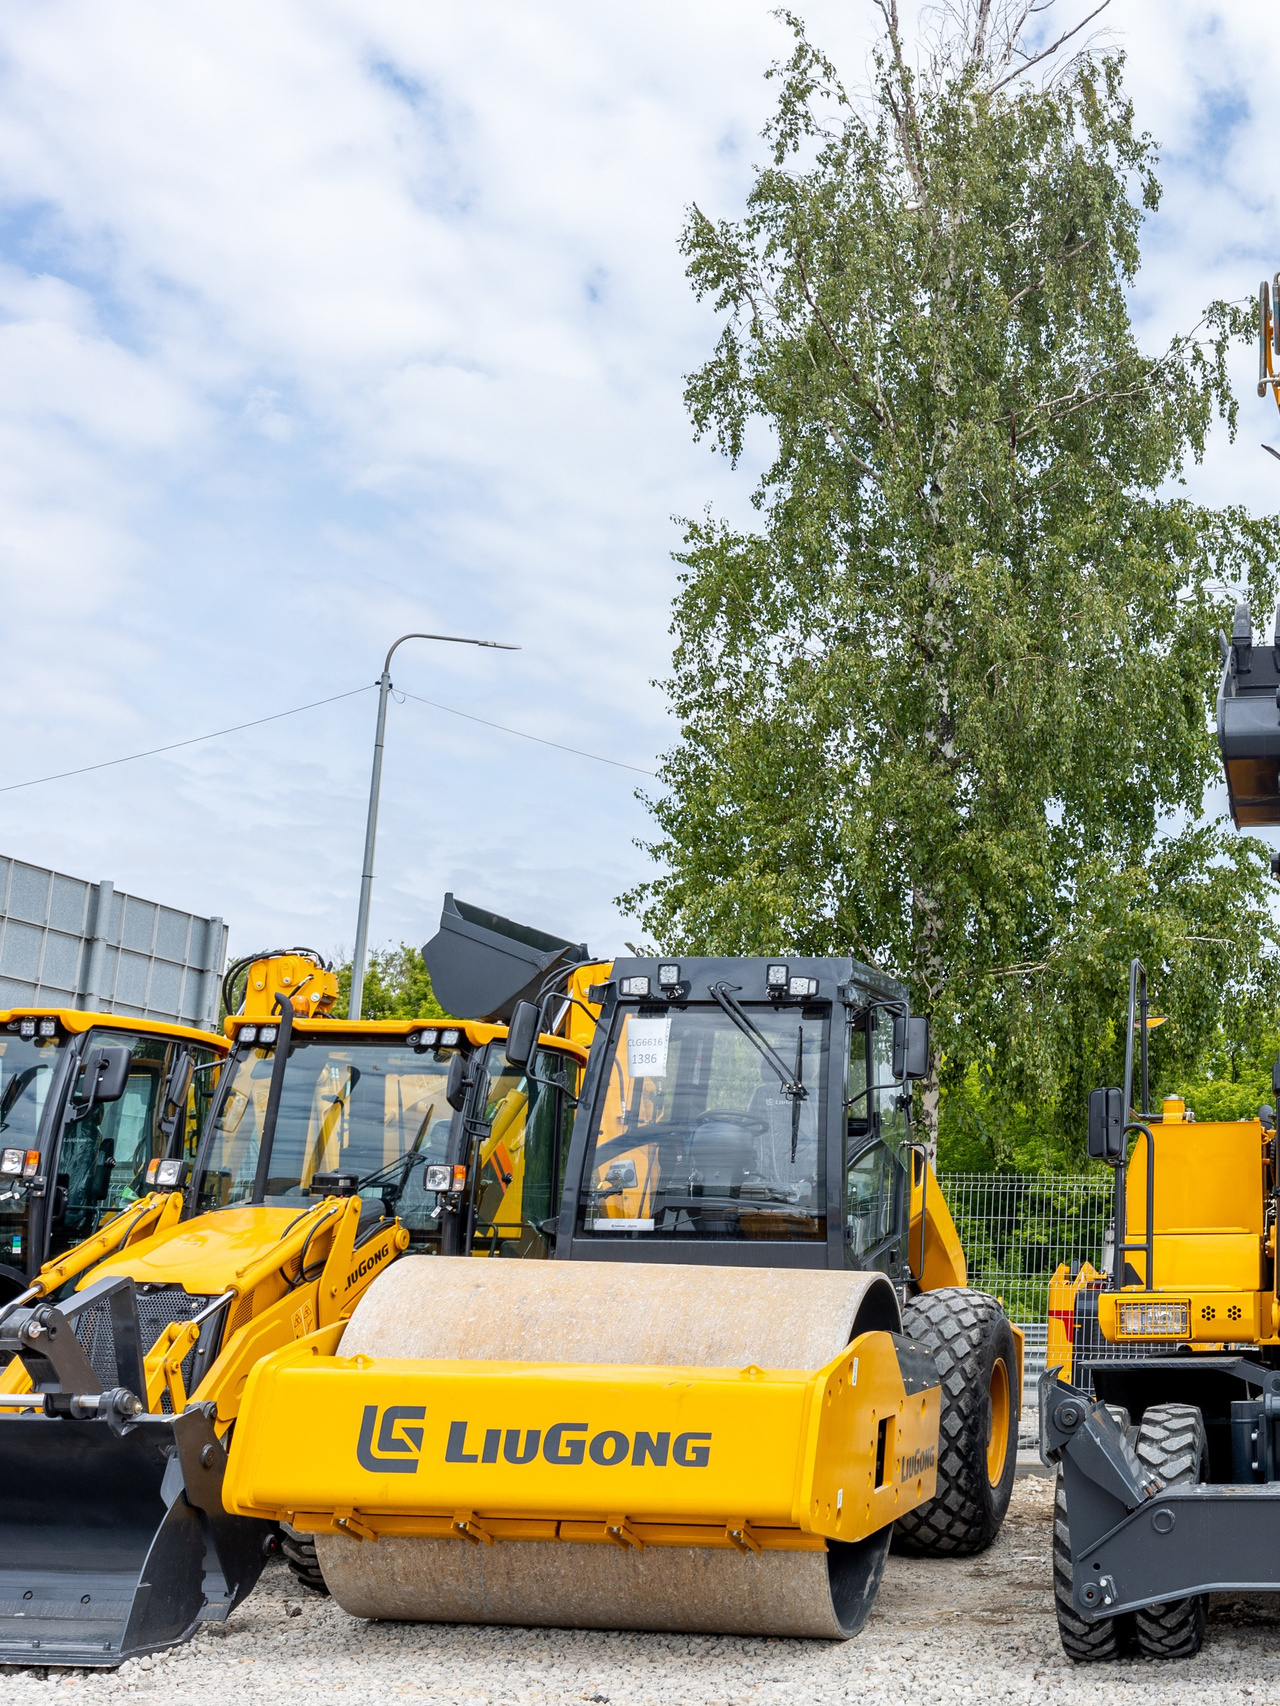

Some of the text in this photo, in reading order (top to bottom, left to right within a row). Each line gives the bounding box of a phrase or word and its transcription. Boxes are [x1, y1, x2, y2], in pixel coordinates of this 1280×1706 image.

[628, 1038, 663, 1047] CLG6616
[632, 1054, 657, 1064] 1386
[344, 1243, 389, 1292] IUGONG
